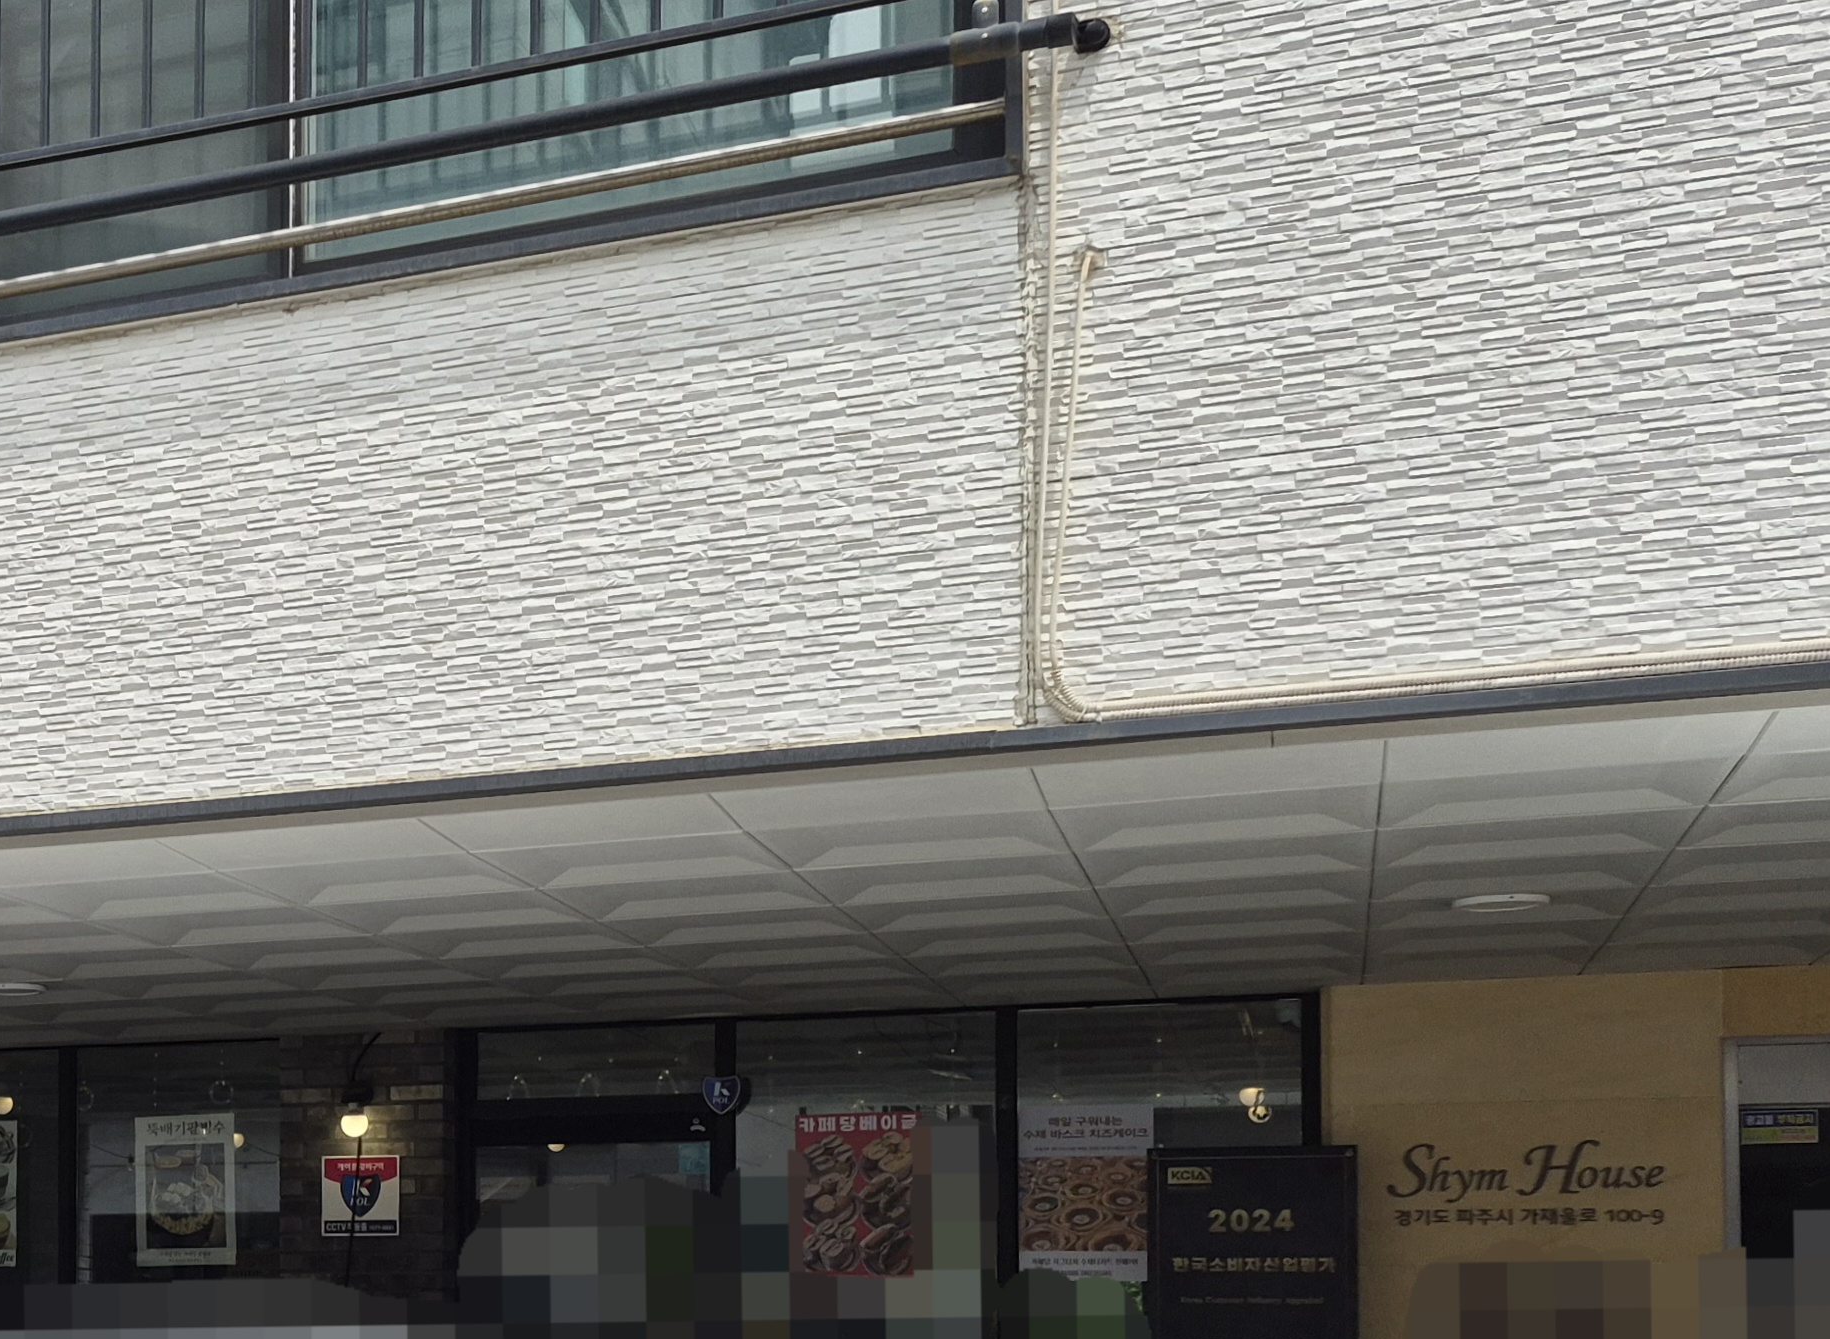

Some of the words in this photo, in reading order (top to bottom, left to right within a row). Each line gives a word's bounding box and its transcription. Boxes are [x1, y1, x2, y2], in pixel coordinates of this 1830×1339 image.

[1048, 1117, 1071, 1126] 매일
[1075, 1116, 1122, 1126] 구워내는
[1023, 1130, 1046, 1139] 수제
[1050, 1129, 1085, 1138] 바스크
[1089, 1128, 1148, 1137] 치즈케이크
[1170, 1171, 1206, 1180] KCIA
[1386, 1142, 1509, 1204] Shym
[1517, 1139, 1665, 1197] House
[1208, 1209, 1295, 1232] 2024
[1394, 1209, 1449, 1227] 경기도
[1455, 1208, 1514, 1227] 파주시
[1520, 1208, 1598, 1225] 가재울로
[1604, 1208, 1665, 1225] 100-9
[326, 1223, 346, 1231] CCTV
